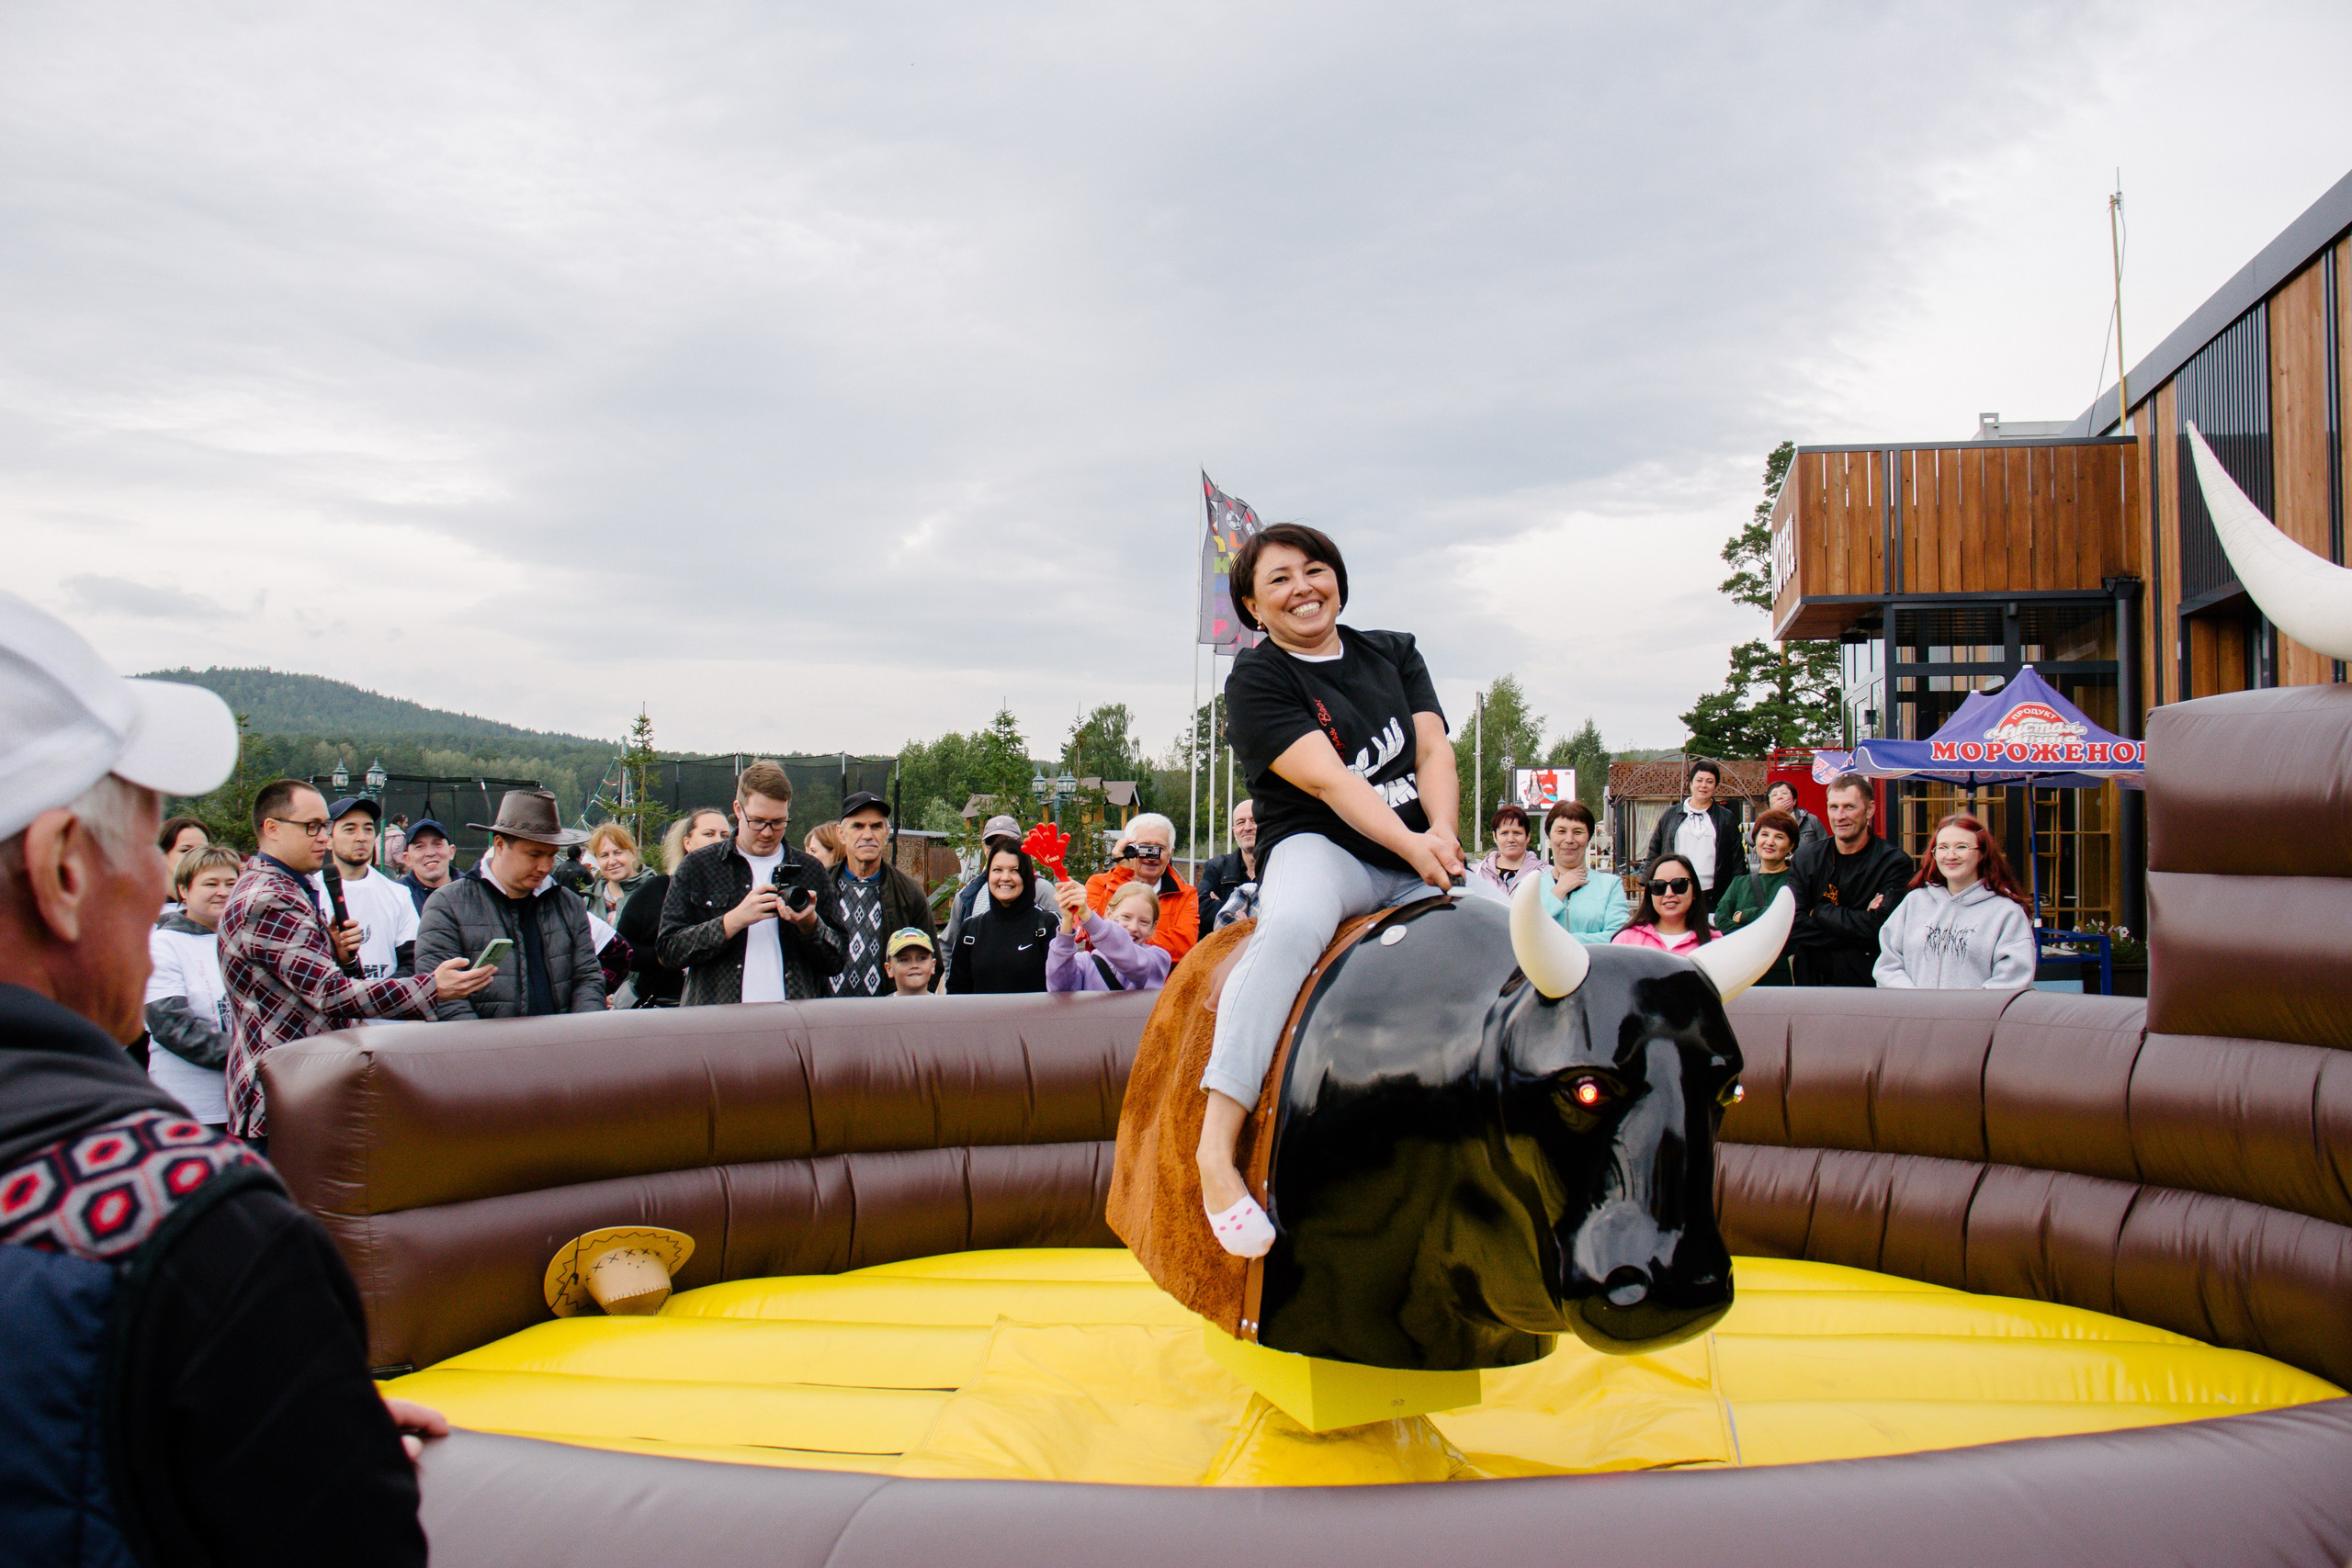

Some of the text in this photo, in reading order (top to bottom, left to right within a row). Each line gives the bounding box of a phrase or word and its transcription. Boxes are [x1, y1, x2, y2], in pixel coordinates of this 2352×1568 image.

[1770, 513, 1794, 604] HOTEL
[2011, 707, 2058, 720] ПРОДУКТ
[1984, 721, 2087, 739] Чистая
